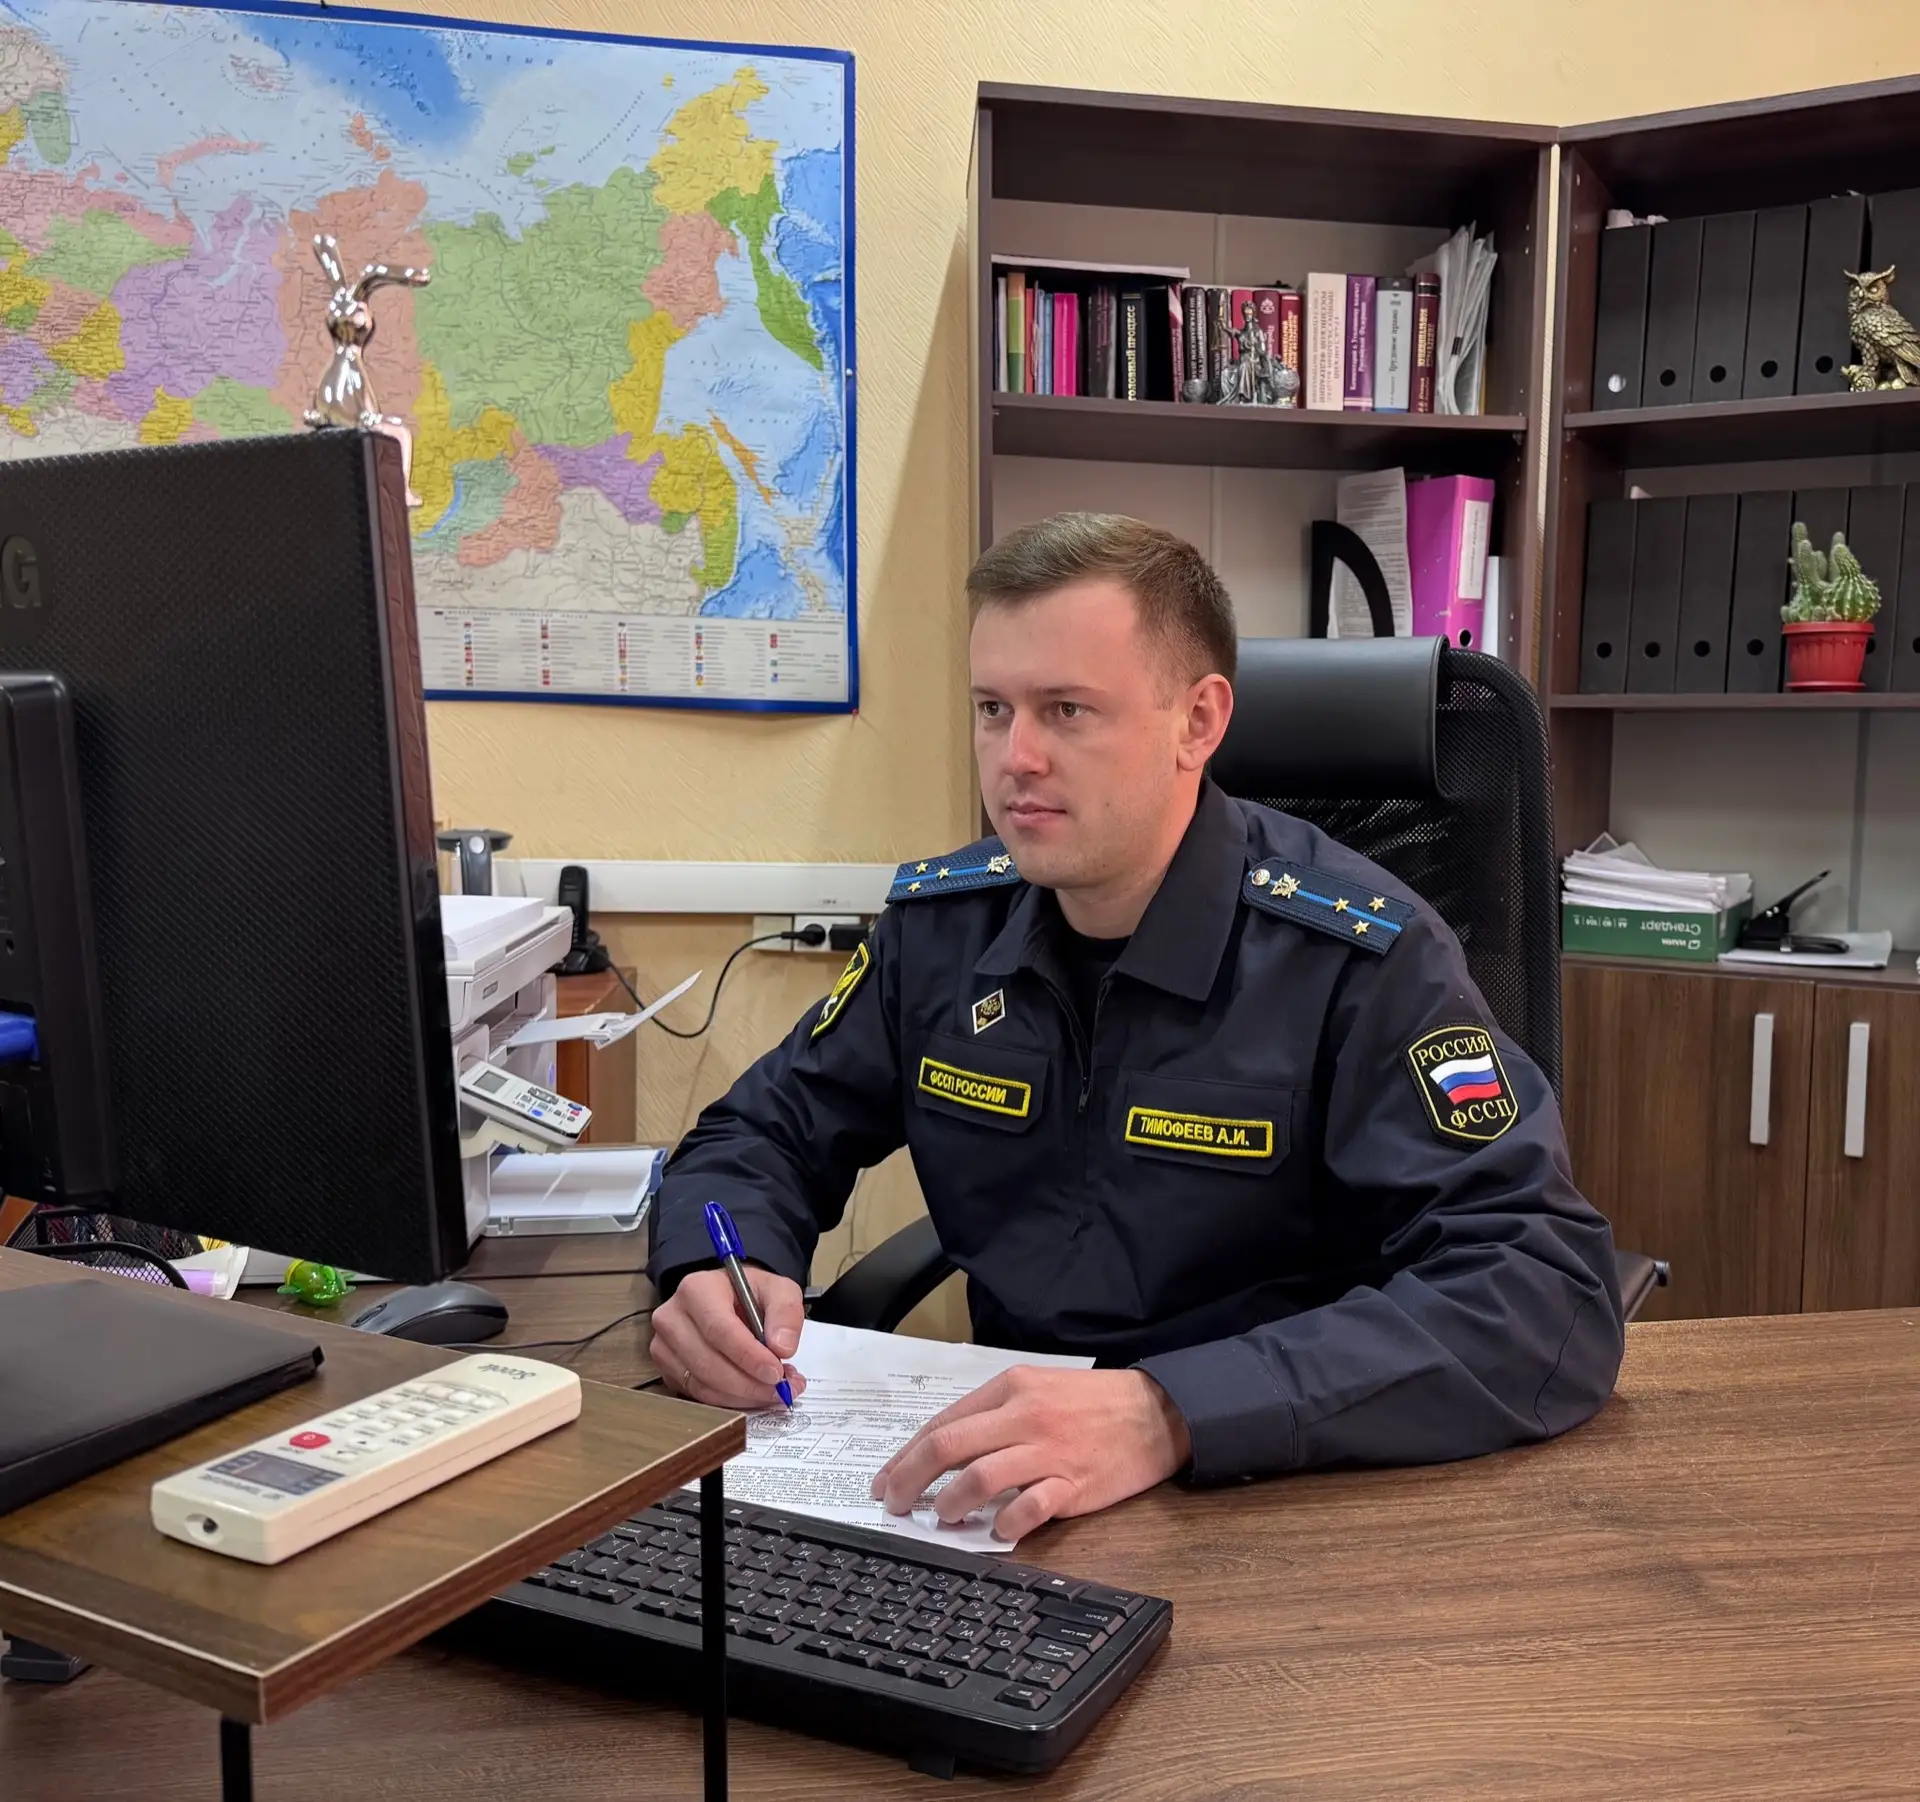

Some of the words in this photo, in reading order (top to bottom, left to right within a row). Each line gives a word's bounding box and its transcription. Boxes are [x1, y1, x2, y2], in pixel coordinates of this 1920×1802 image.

[1127, 304, 1137, 349] ПРОЦЕСС
[1391, 309, 1400, 334] право
[1388, 337, 1398, 372] Трудовое
[1127, 350, 1137, 401] ГОЛОВНЫЙ
[1640, 920, 1701, 936] Стандарт
[1415, 1034, 1491, 1067] РОССИЯ
[930, 1070, 955, 1092] ФССП
[956, 1080, 1007, 1104] РОССИИ
[1140, 1115, 1214, 1142] ТИМОФЕЕВ
[1216, 1128, 1250, 1146] А.И.
[1450, 1098, 1513, 1130] ФССП
